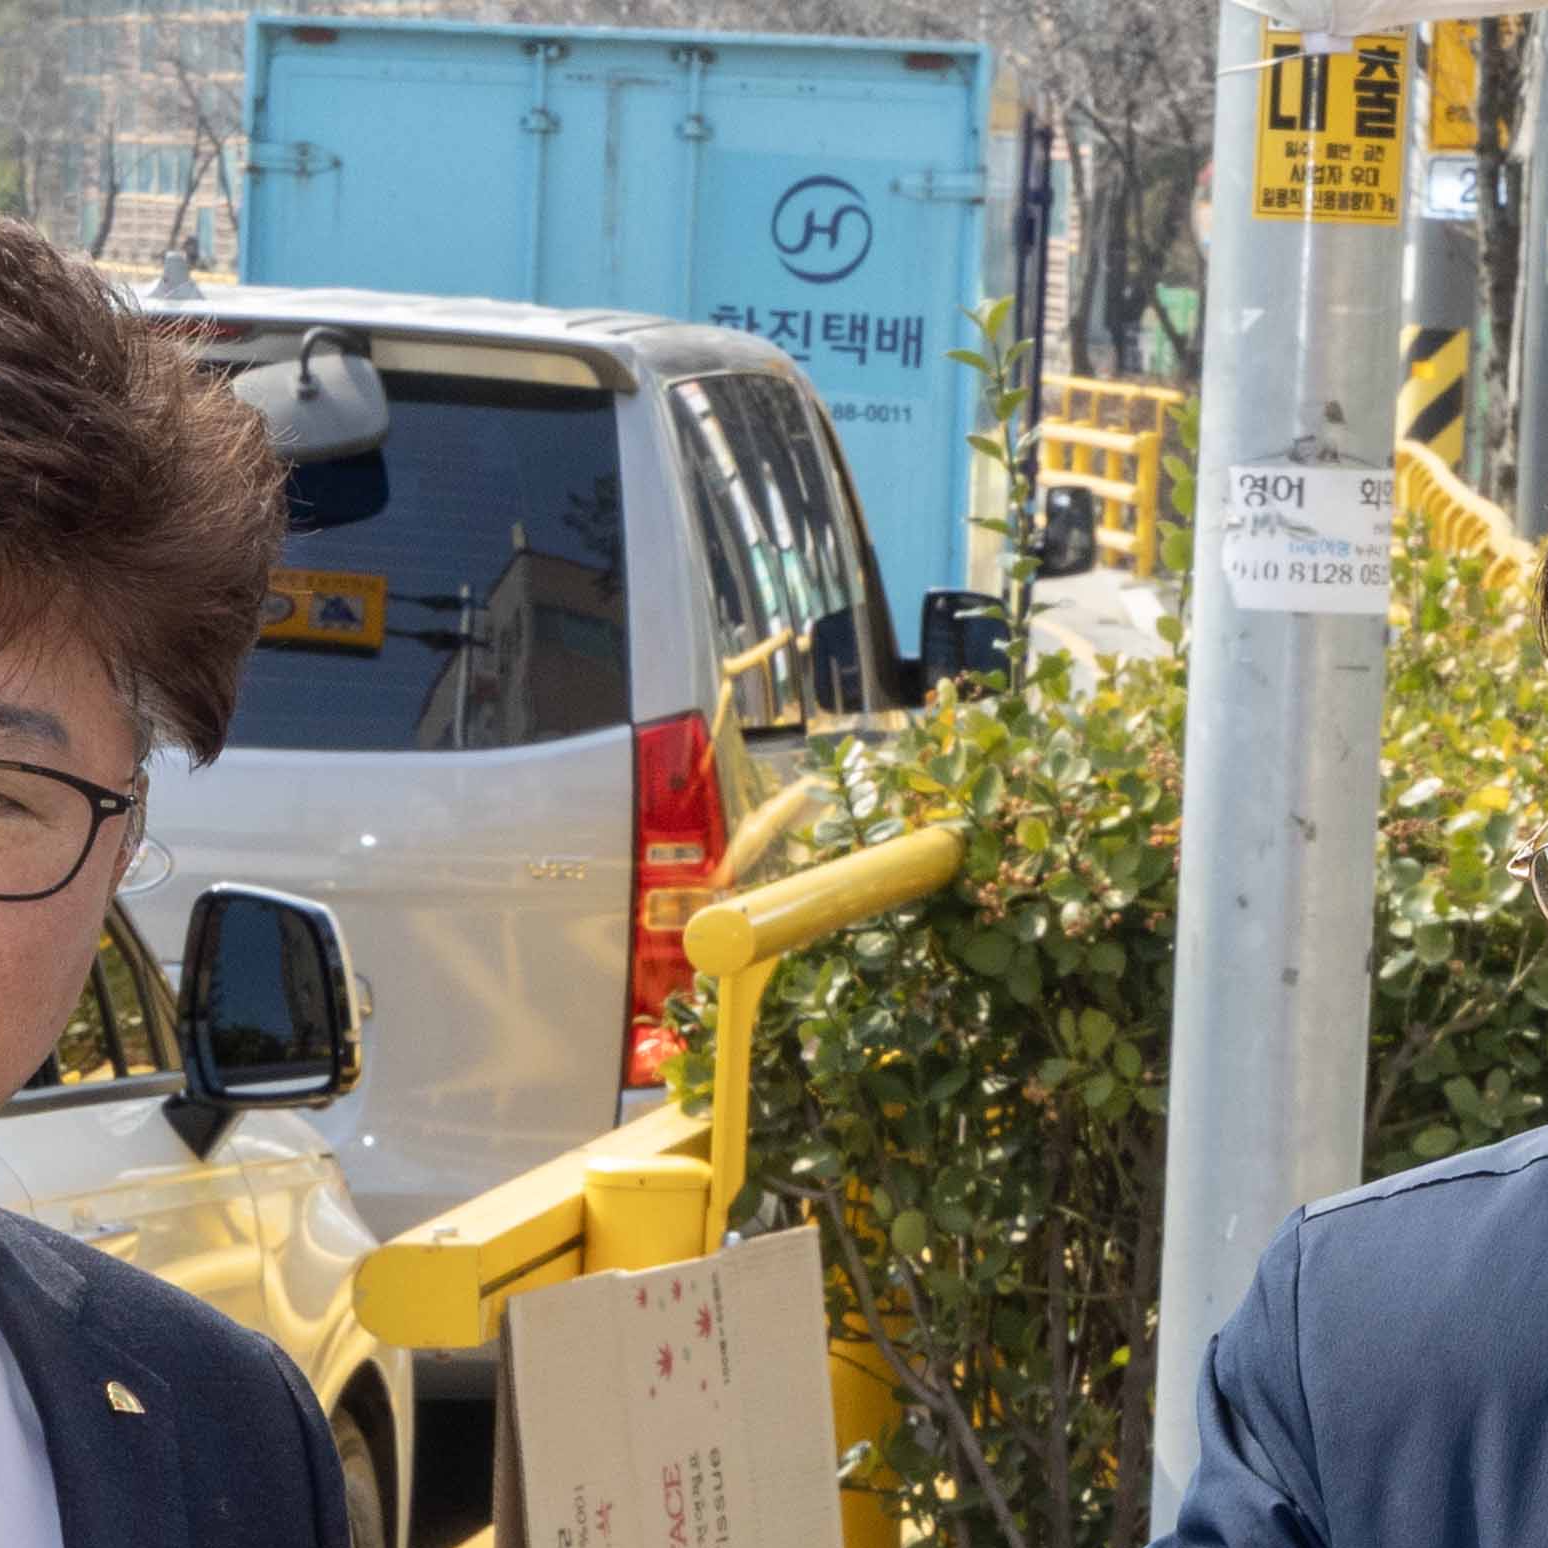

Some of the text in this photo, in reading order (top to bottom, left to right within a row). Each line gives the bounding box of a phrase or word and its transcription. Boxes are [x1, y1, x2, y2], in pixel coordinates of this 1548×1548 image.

[1350, 167, 1380, 188] 우대
[1239, 474, 1305, 508] 영어
[1289, 561, 1353, 585] 8128
